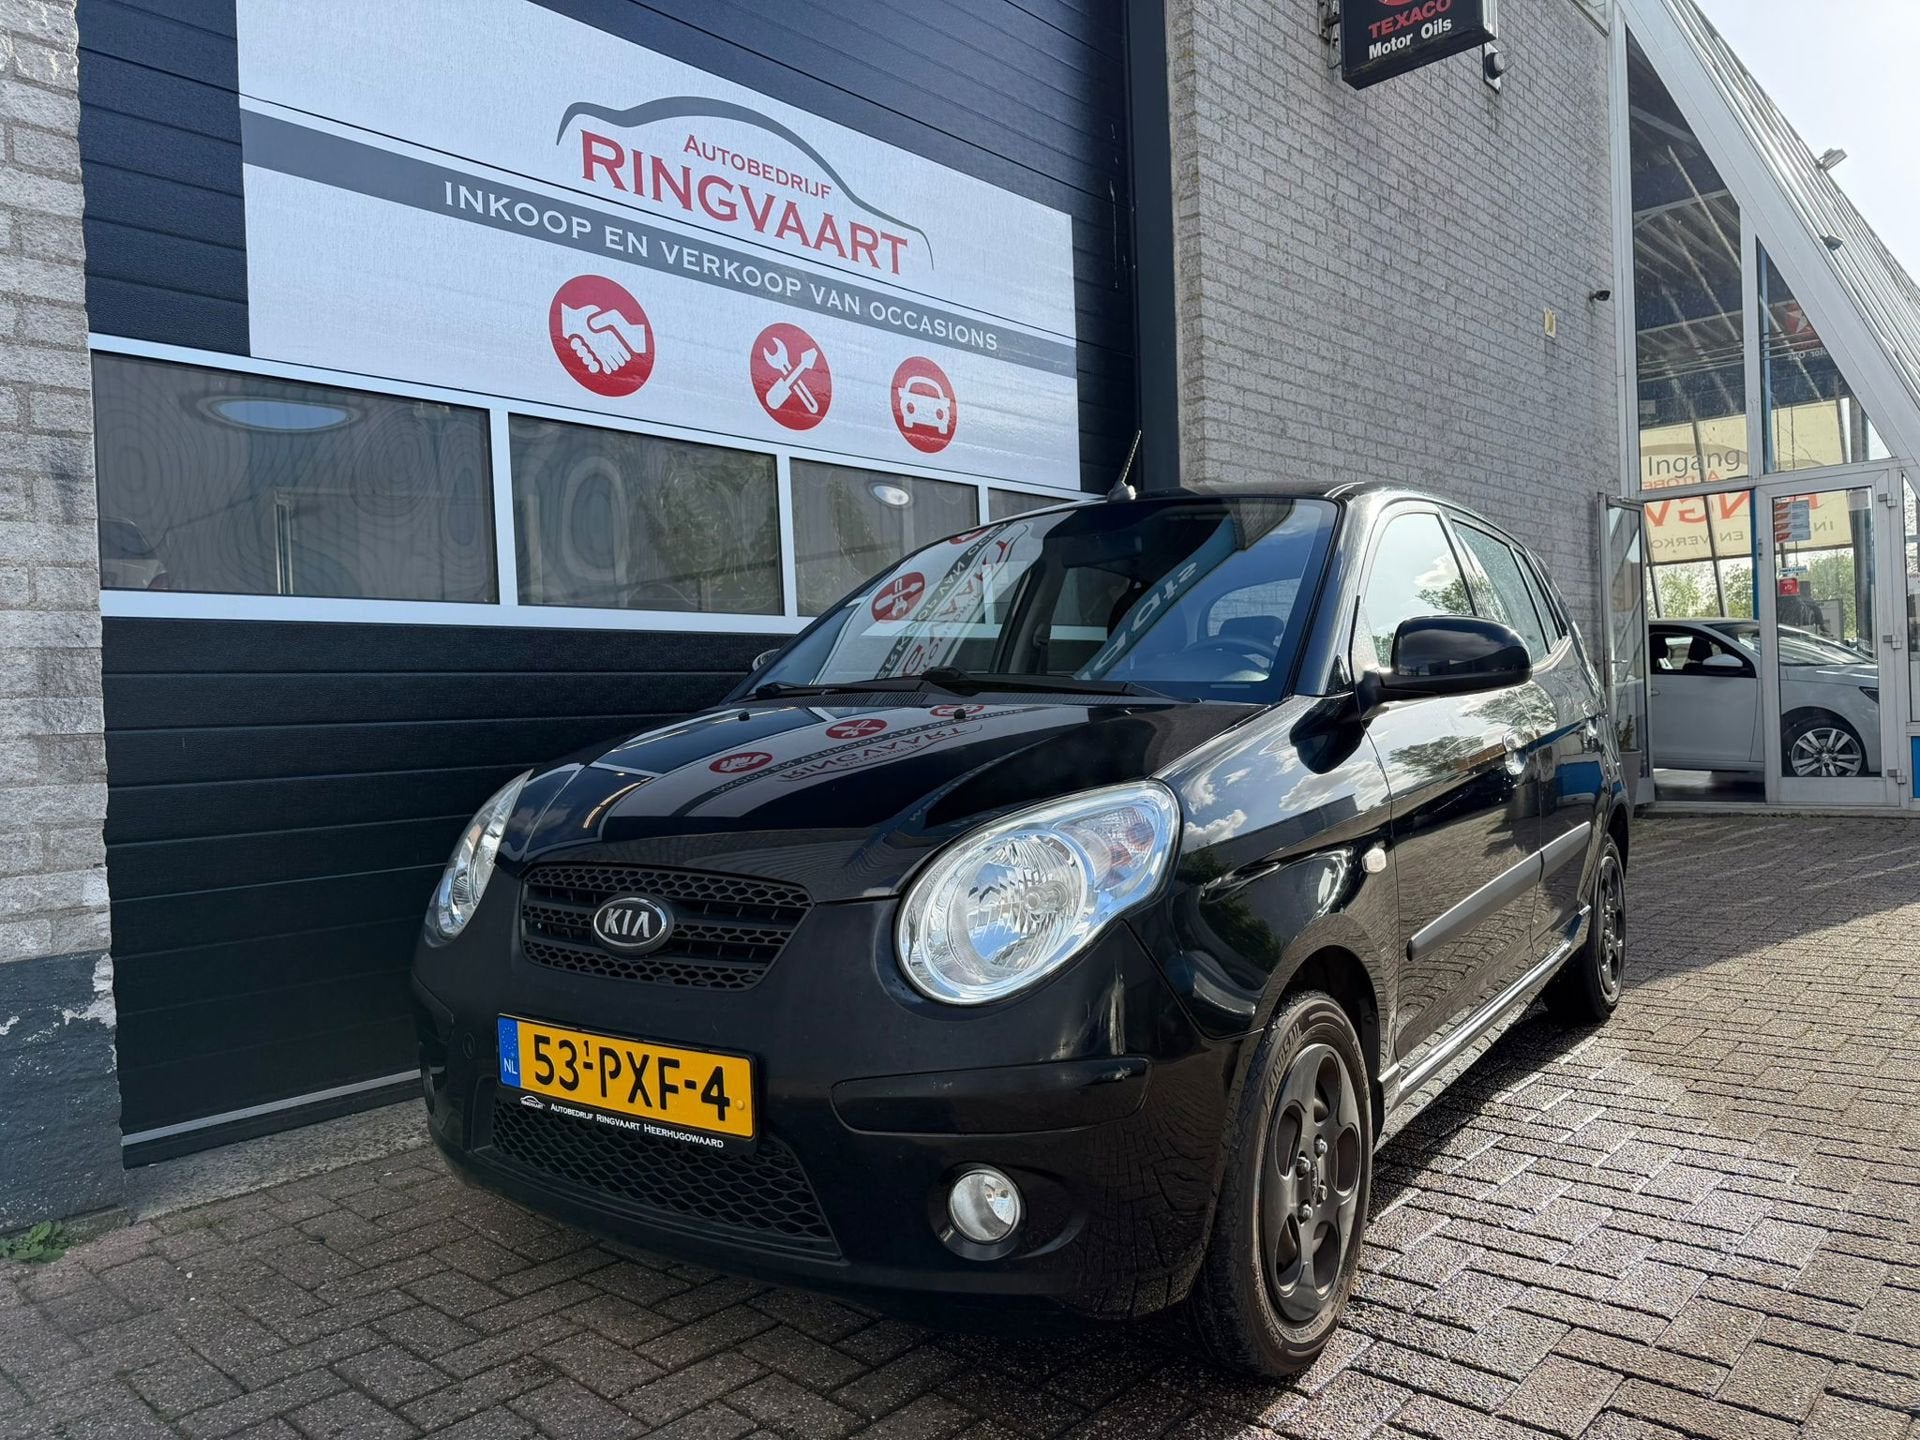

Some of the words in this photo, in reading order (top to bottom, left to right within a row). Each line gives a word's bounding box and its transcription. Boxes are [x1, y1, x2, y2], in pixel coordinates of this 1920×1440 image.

[1368, 0, 1451, 39] TEXACO
[1368, 32, 1414, 60] Motor
[1420, 18, 1452, 39] Oils
[580, 129, 908, 275] RINGVAART
[444, 180, 592, 239] INKOOP
[604, 225, 649, 258] EN
[660, 240, 801, 297] VERKOOP
[809, 283, 861, 316] VAN
[869, 302, 998, 351] OCCASIONS
[1648, 449, 1741, 479] Ingang
[602, 906, 651, 938] KIA
[503, 1060, 519, 1076] NL
[596, 1112, 641, 1132] RINGVAART
[643, 1123, 724, 1149] HEERHUGOWAARD
